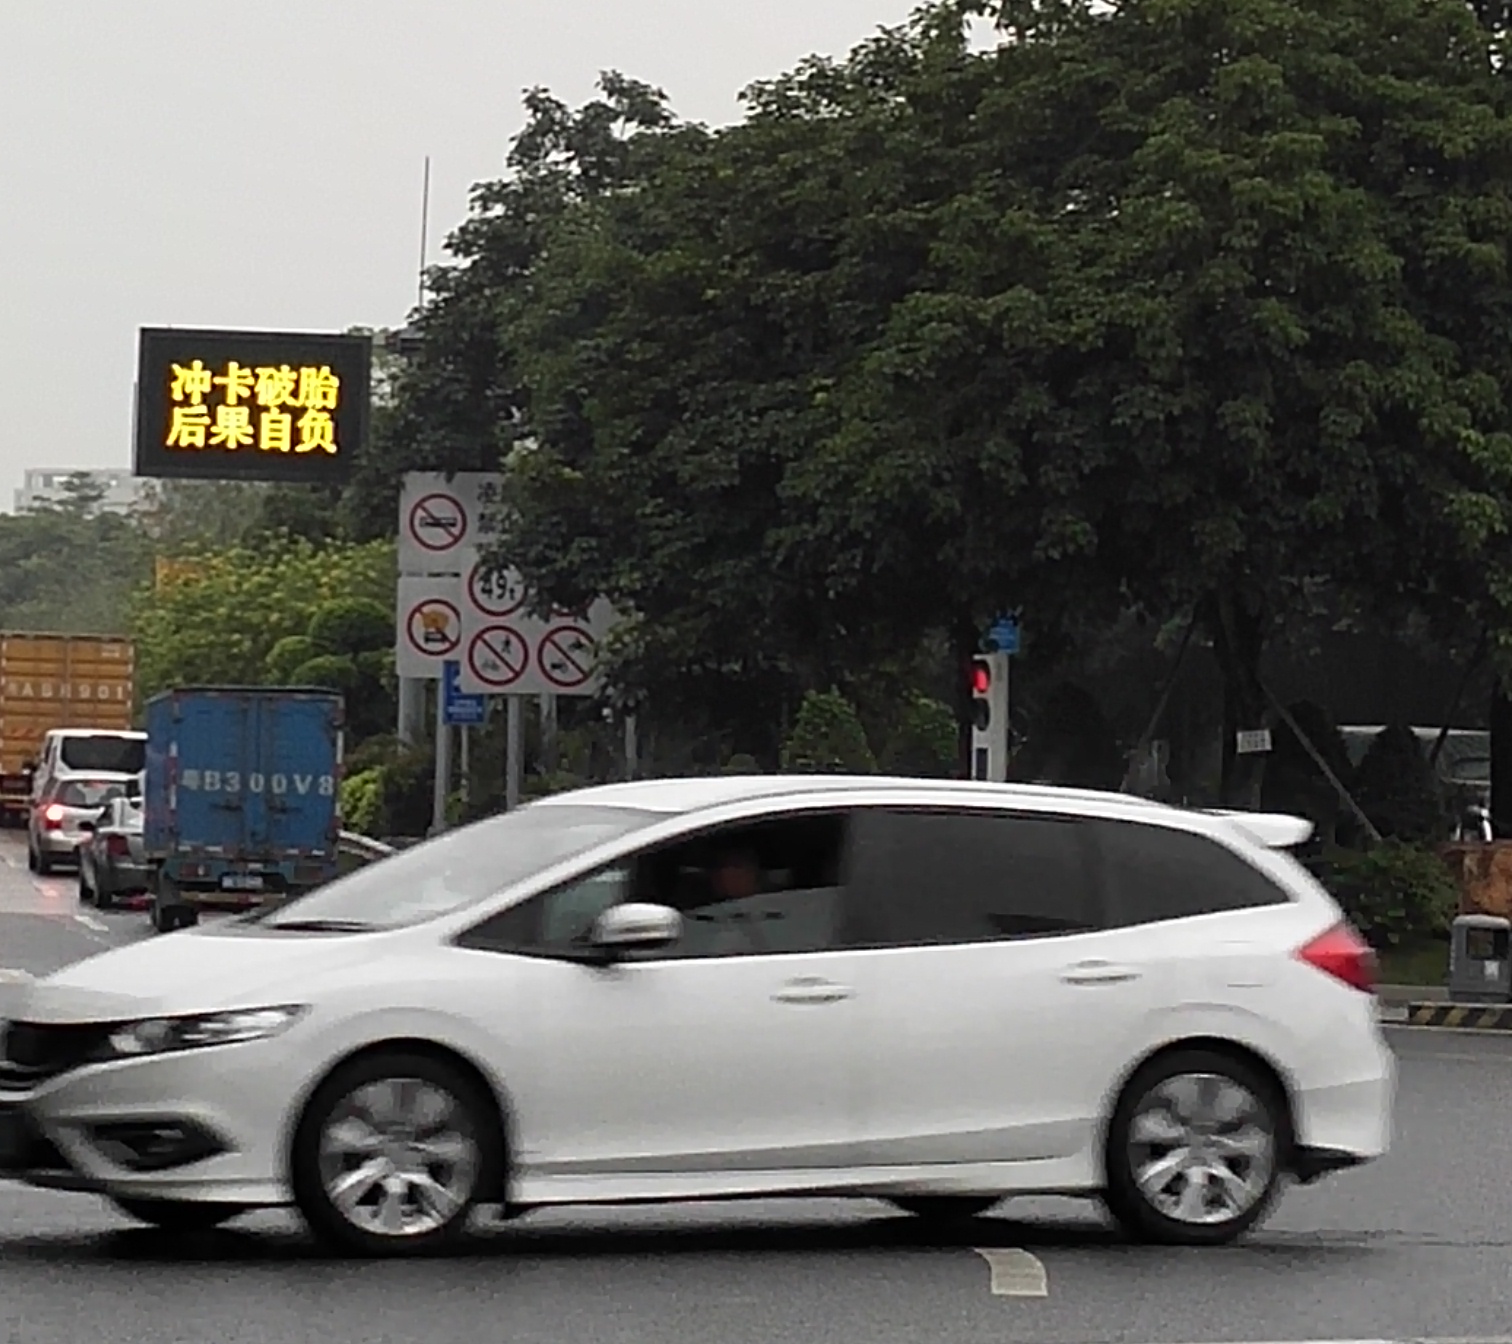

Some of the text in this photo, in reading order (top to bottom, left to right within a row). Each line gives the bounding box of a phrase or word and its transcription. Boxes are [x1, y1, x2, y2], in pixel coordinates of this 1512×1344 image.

[170, 359, 340, 410] 冲卡破胎
[165, 404, 338, 454] 后果自负
